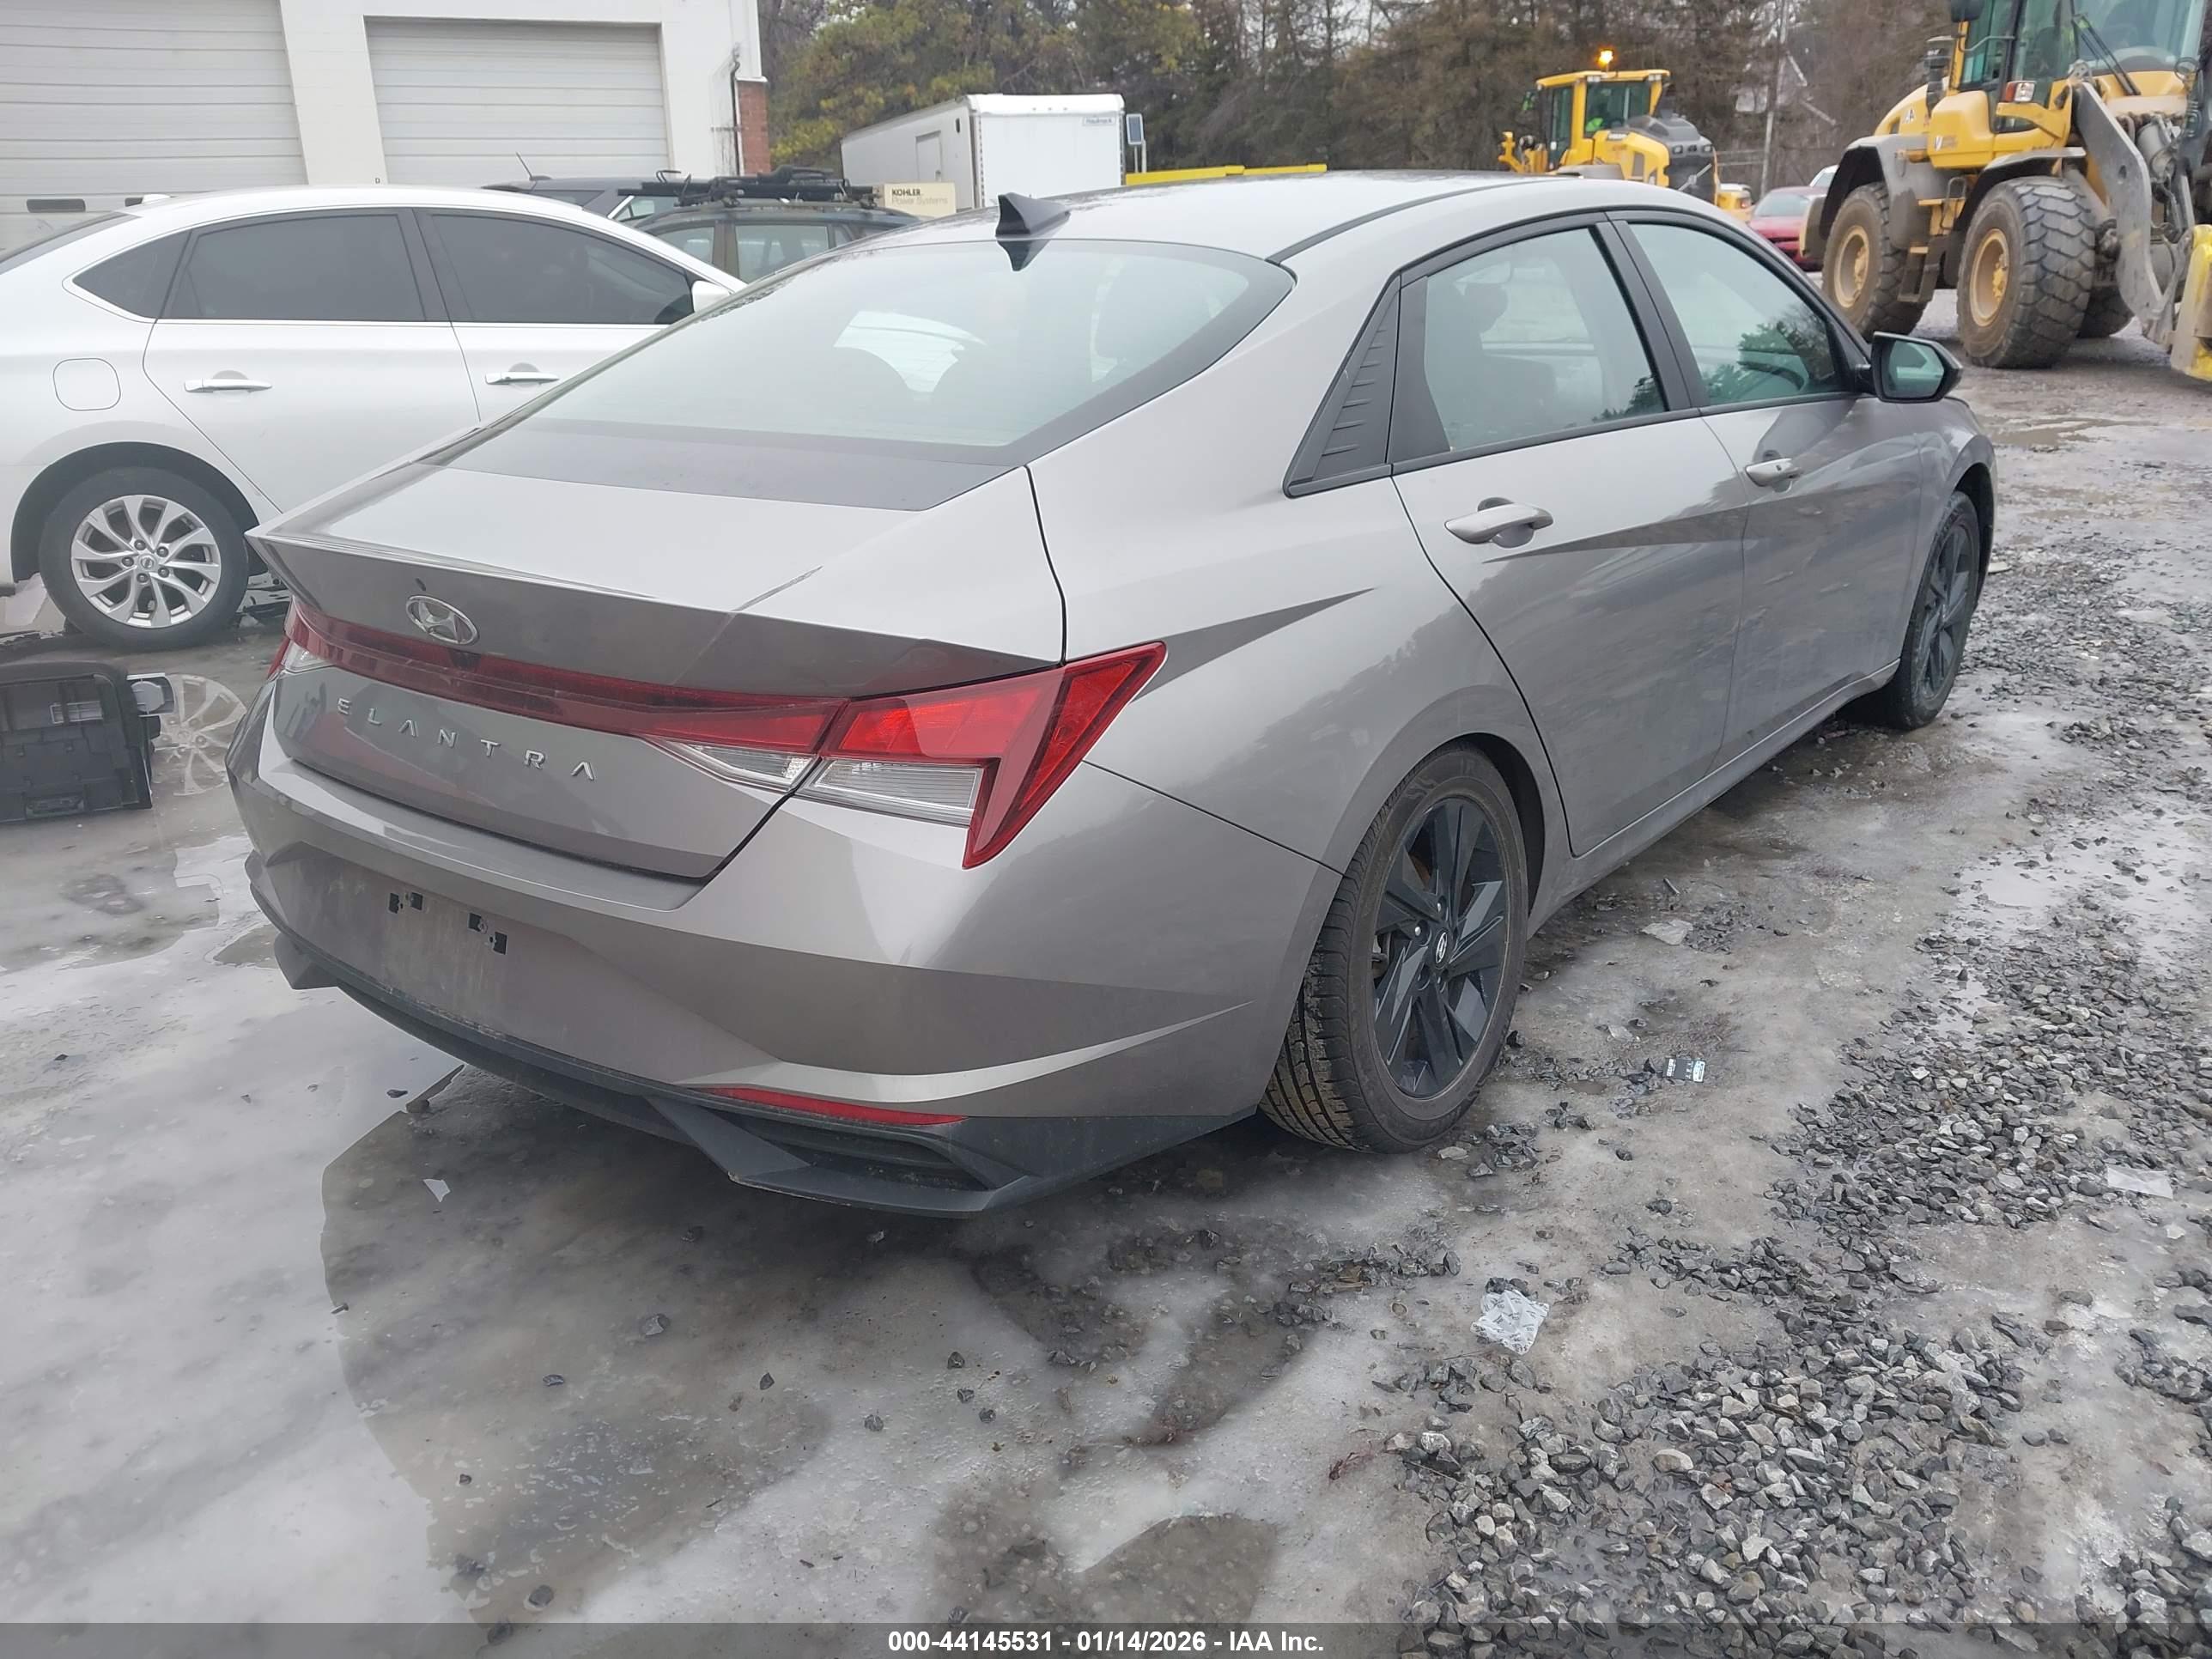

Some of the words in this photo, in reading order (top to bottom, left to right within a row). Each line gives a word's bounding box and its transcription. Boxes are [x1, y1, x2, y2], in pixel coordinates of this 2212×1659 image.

[891, 188, 921, 197] KOHLER
[917, 197, 949, 205] Systems
[337, 697, 598, 782] ELANTRA
